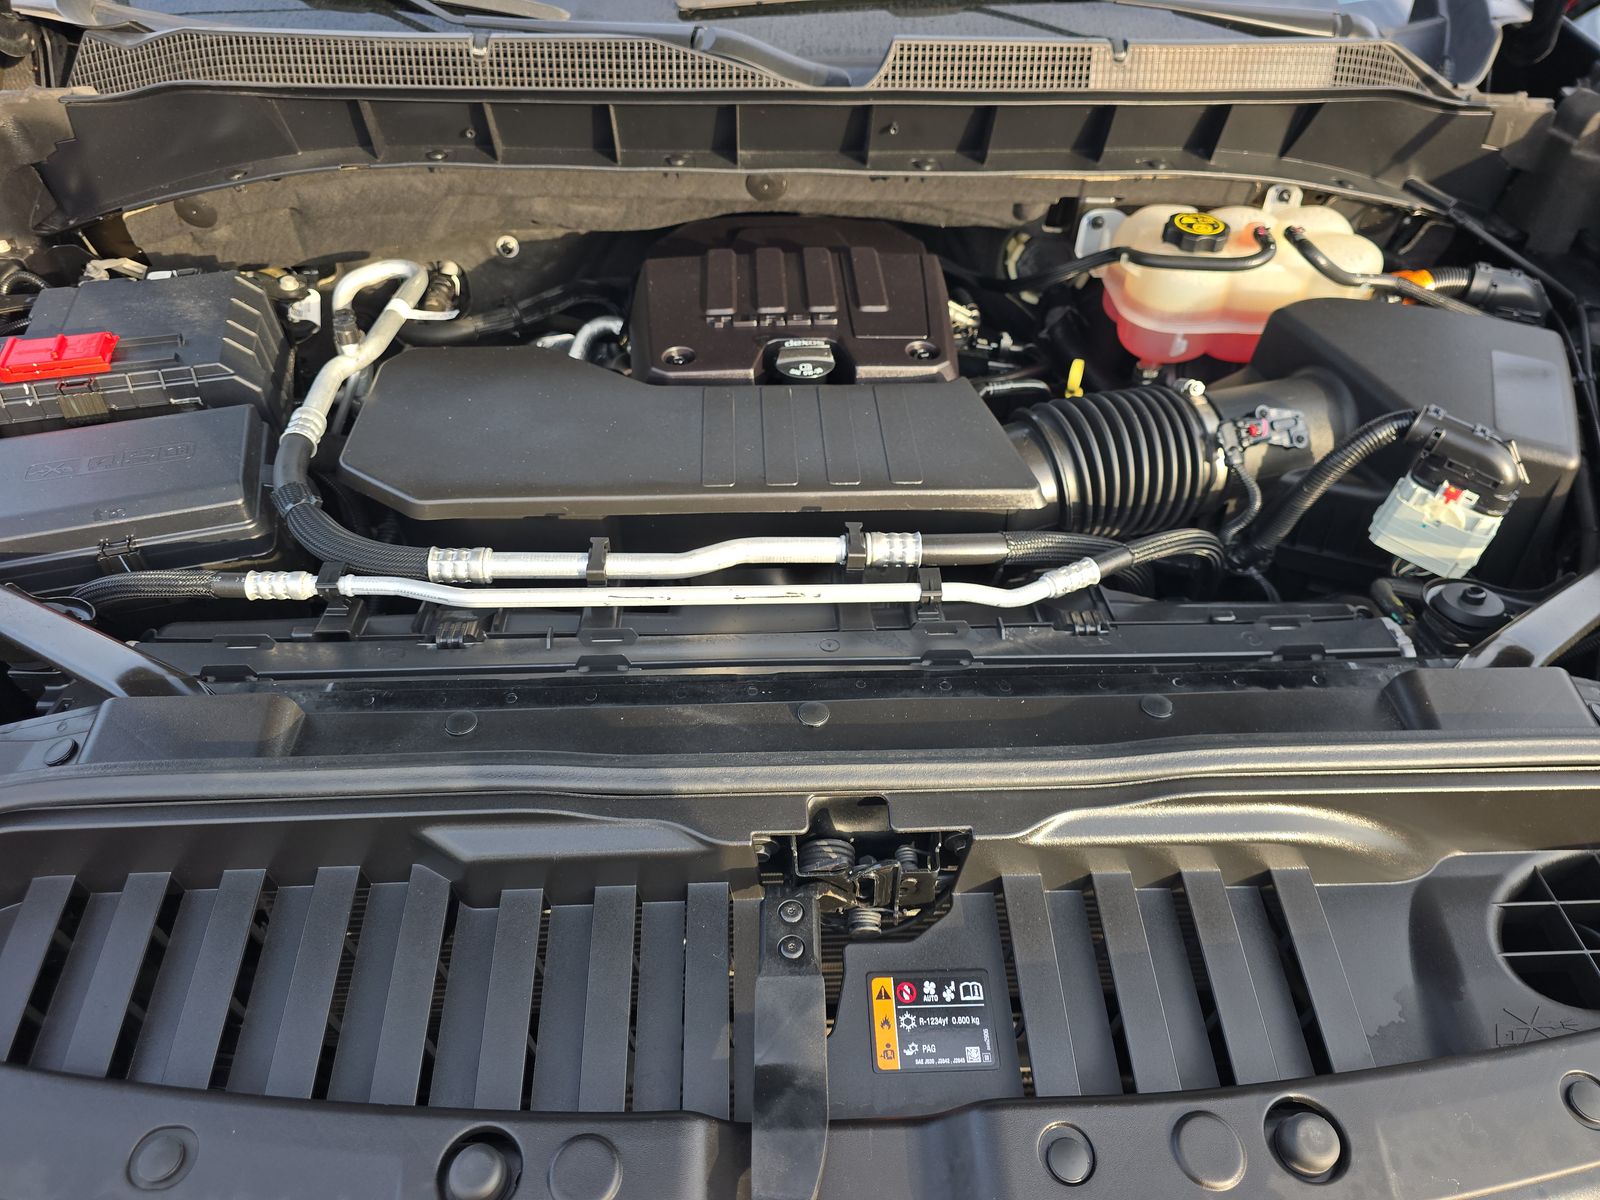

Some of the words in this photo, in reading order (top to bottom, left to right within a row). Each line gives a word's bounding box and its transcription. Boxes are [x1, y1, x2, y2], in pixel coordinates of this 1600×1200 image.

[919, 1016, 948, 1026] R-1234yf
[971, 1016, 980, 1026] kg
[922, 1044, 936, 1053] PAG
